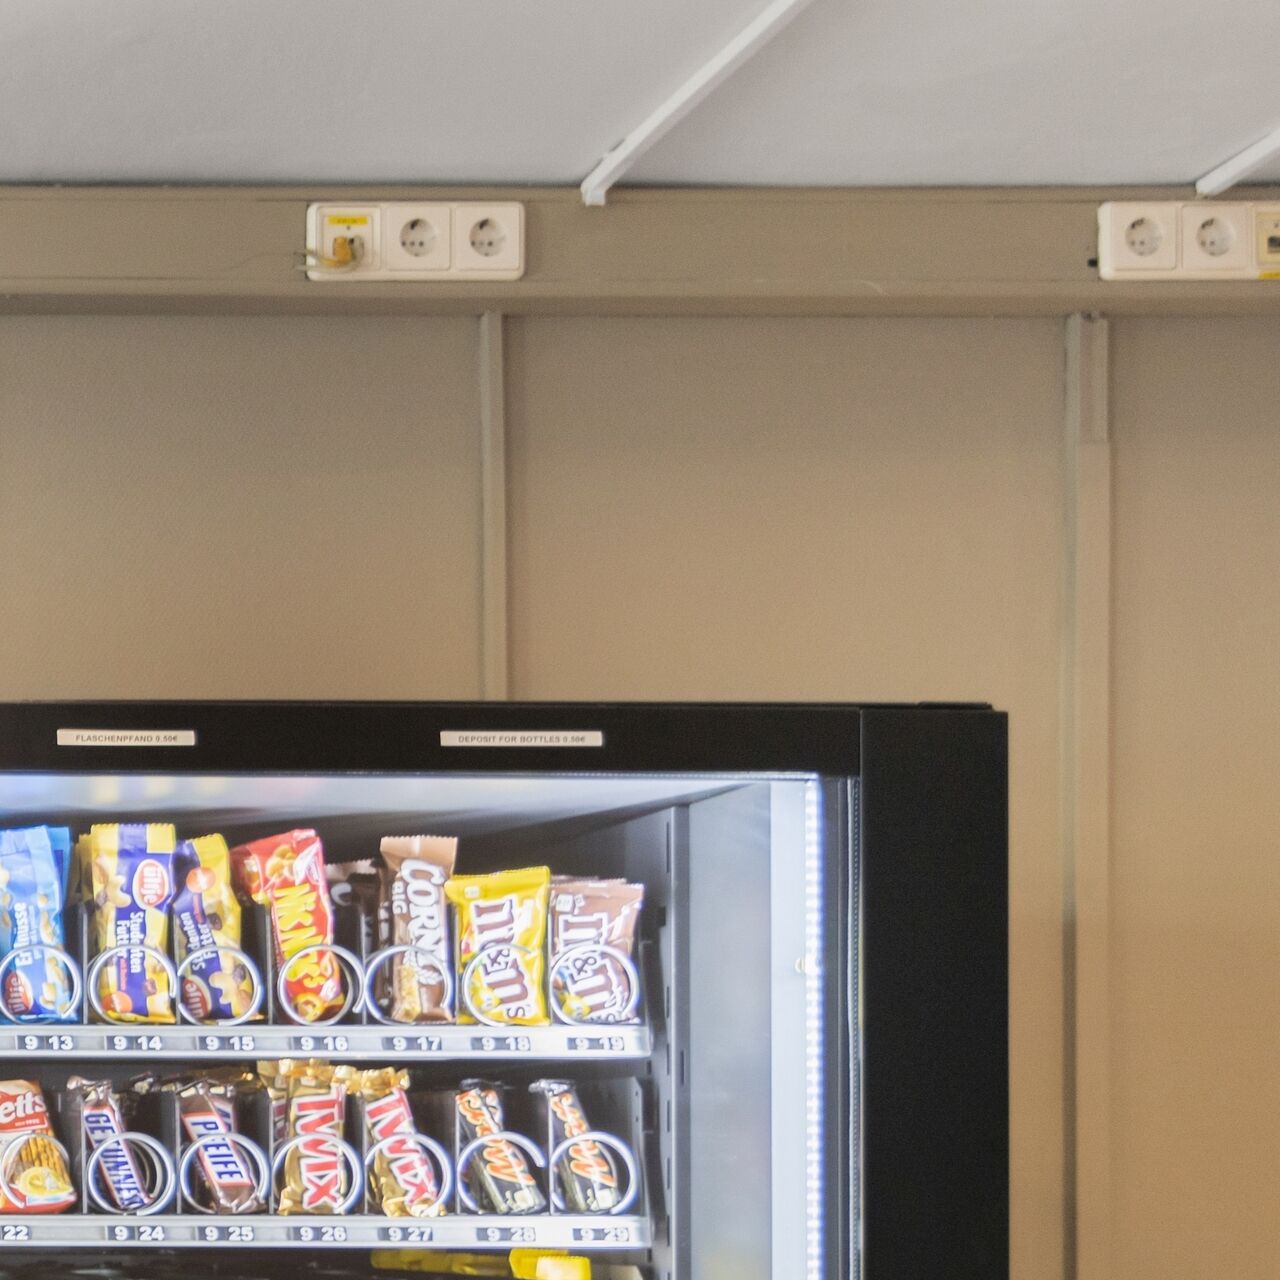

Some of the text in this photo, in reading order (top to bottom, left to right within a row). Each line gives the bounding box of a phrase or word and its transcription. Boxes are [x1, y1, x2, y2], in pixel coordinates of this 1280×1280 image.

[392, 880, 408, 914] BIG
[191, 1121, 244, 1180] PEIFE
[296, 1084, 346, 1208] TWIX
[366, 1088, 440, 1205] TWIX
